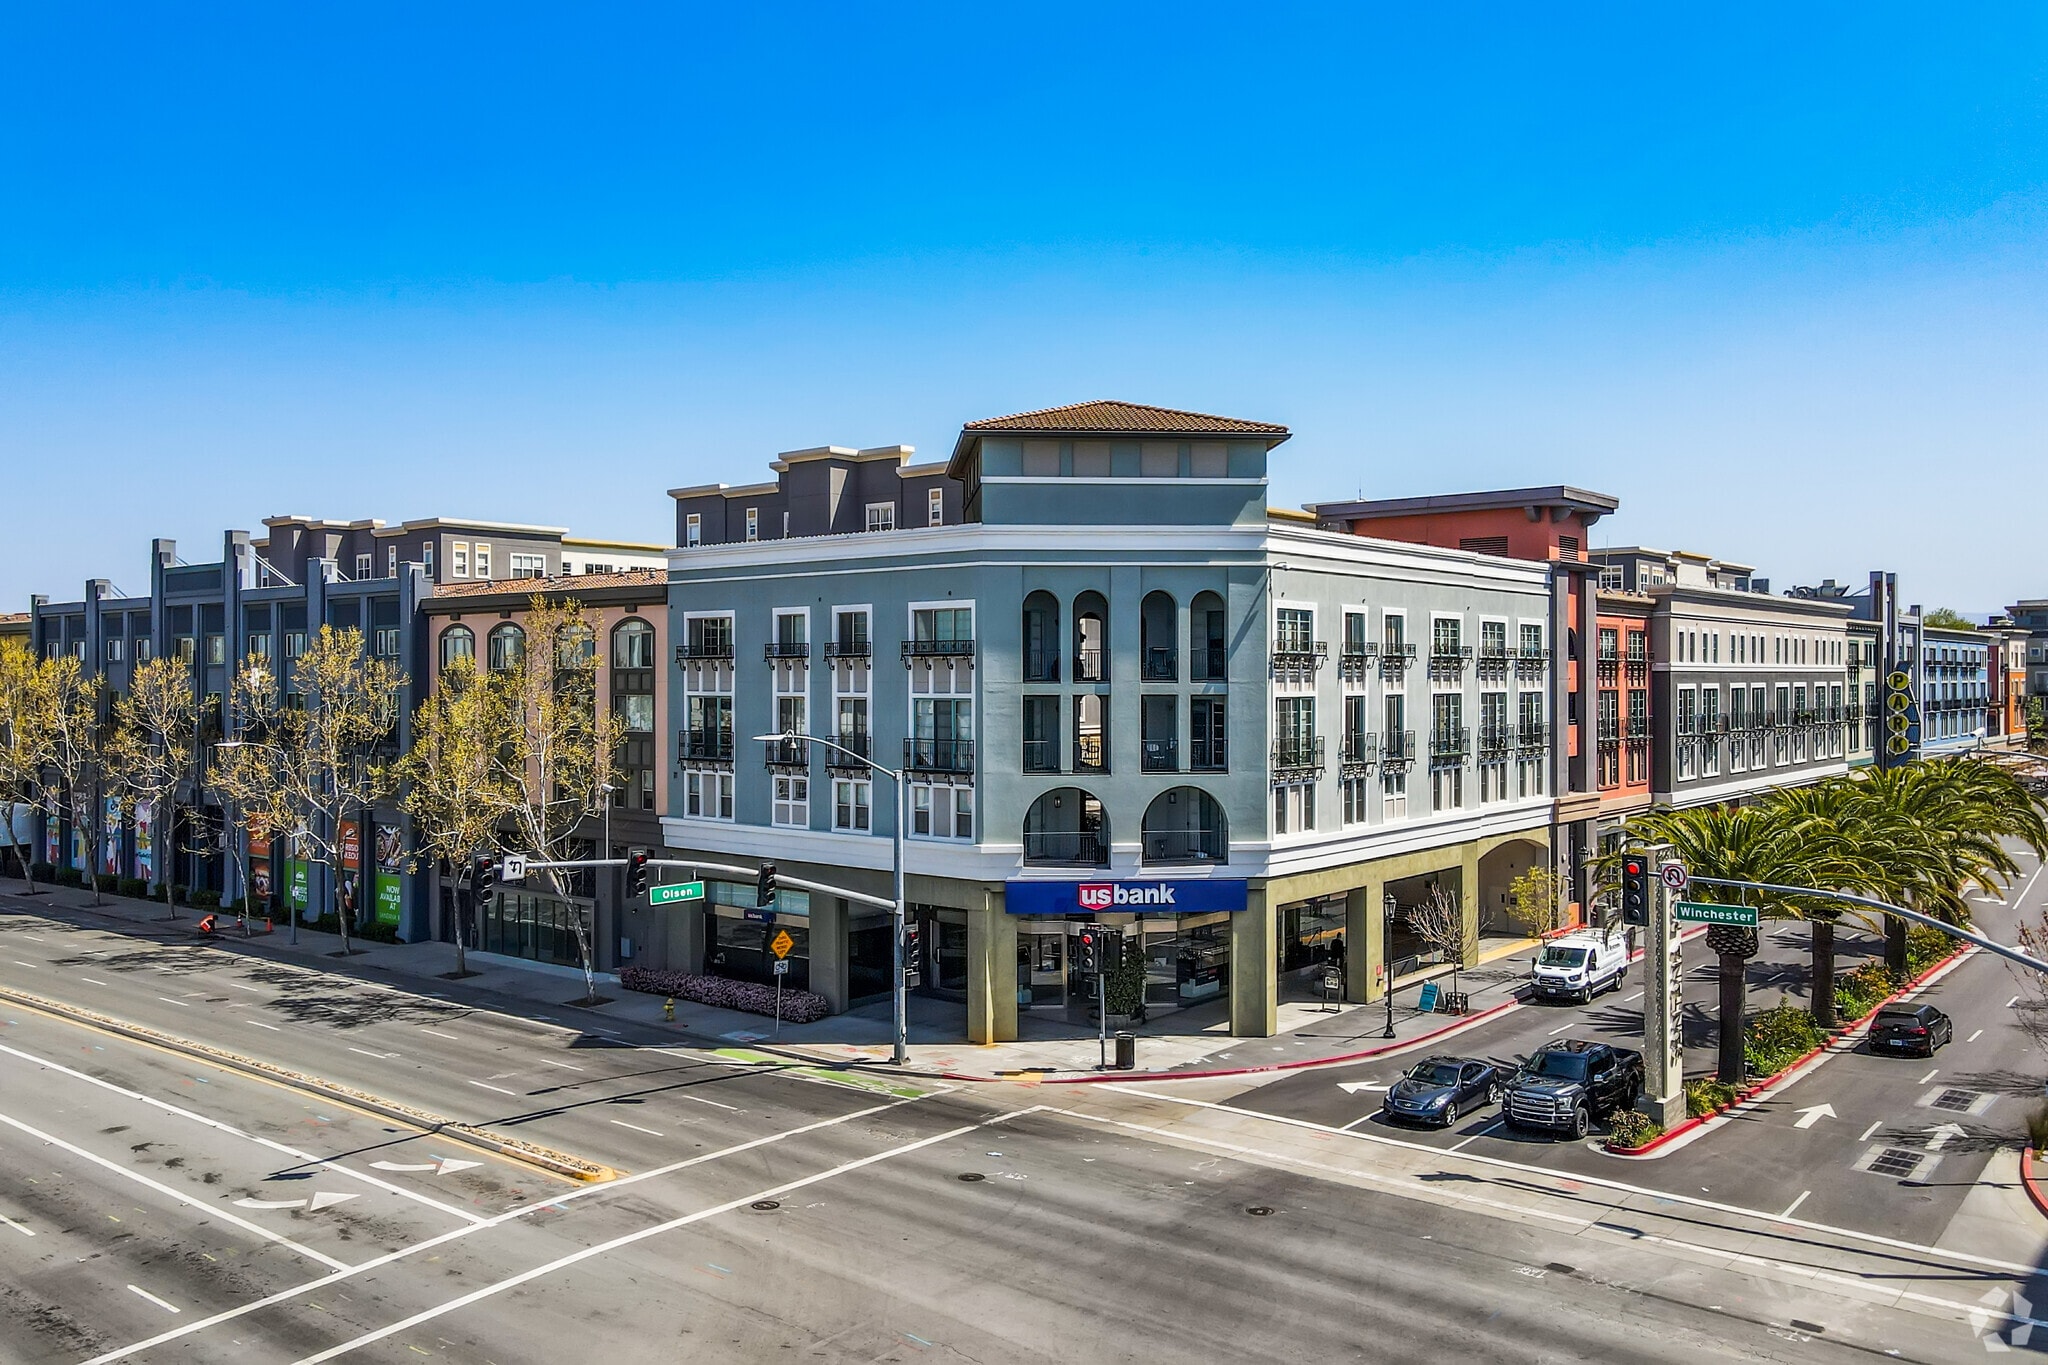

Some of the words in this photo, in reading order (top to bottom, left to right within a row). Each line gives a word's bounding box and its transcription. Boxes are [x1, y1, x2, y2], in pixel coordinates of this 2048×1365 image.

[1893, 674, 1904, 752] PARK
[662, 888, 693, 899] Olsen
[1680, 906, 1753, 922] Winchester
